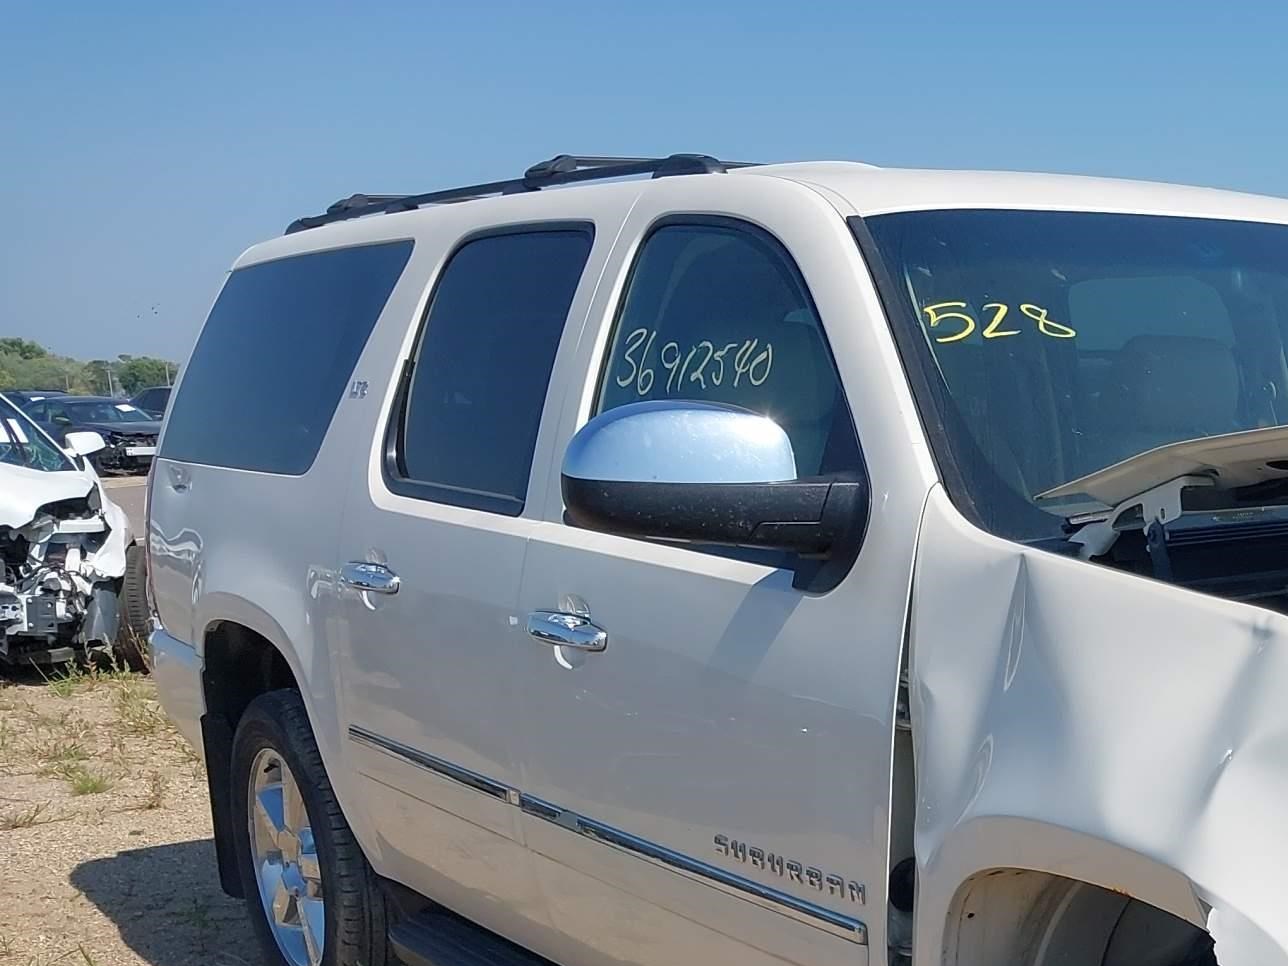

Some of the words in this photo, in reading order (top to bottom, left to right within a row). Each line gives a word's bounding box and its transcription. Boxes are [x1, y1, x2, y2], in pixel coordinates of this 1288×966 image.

[923, 300, 1077, 345] 528
[615, 326, 775, 397] 36912540
[713, 833, 867, 906] SUBURBAN
